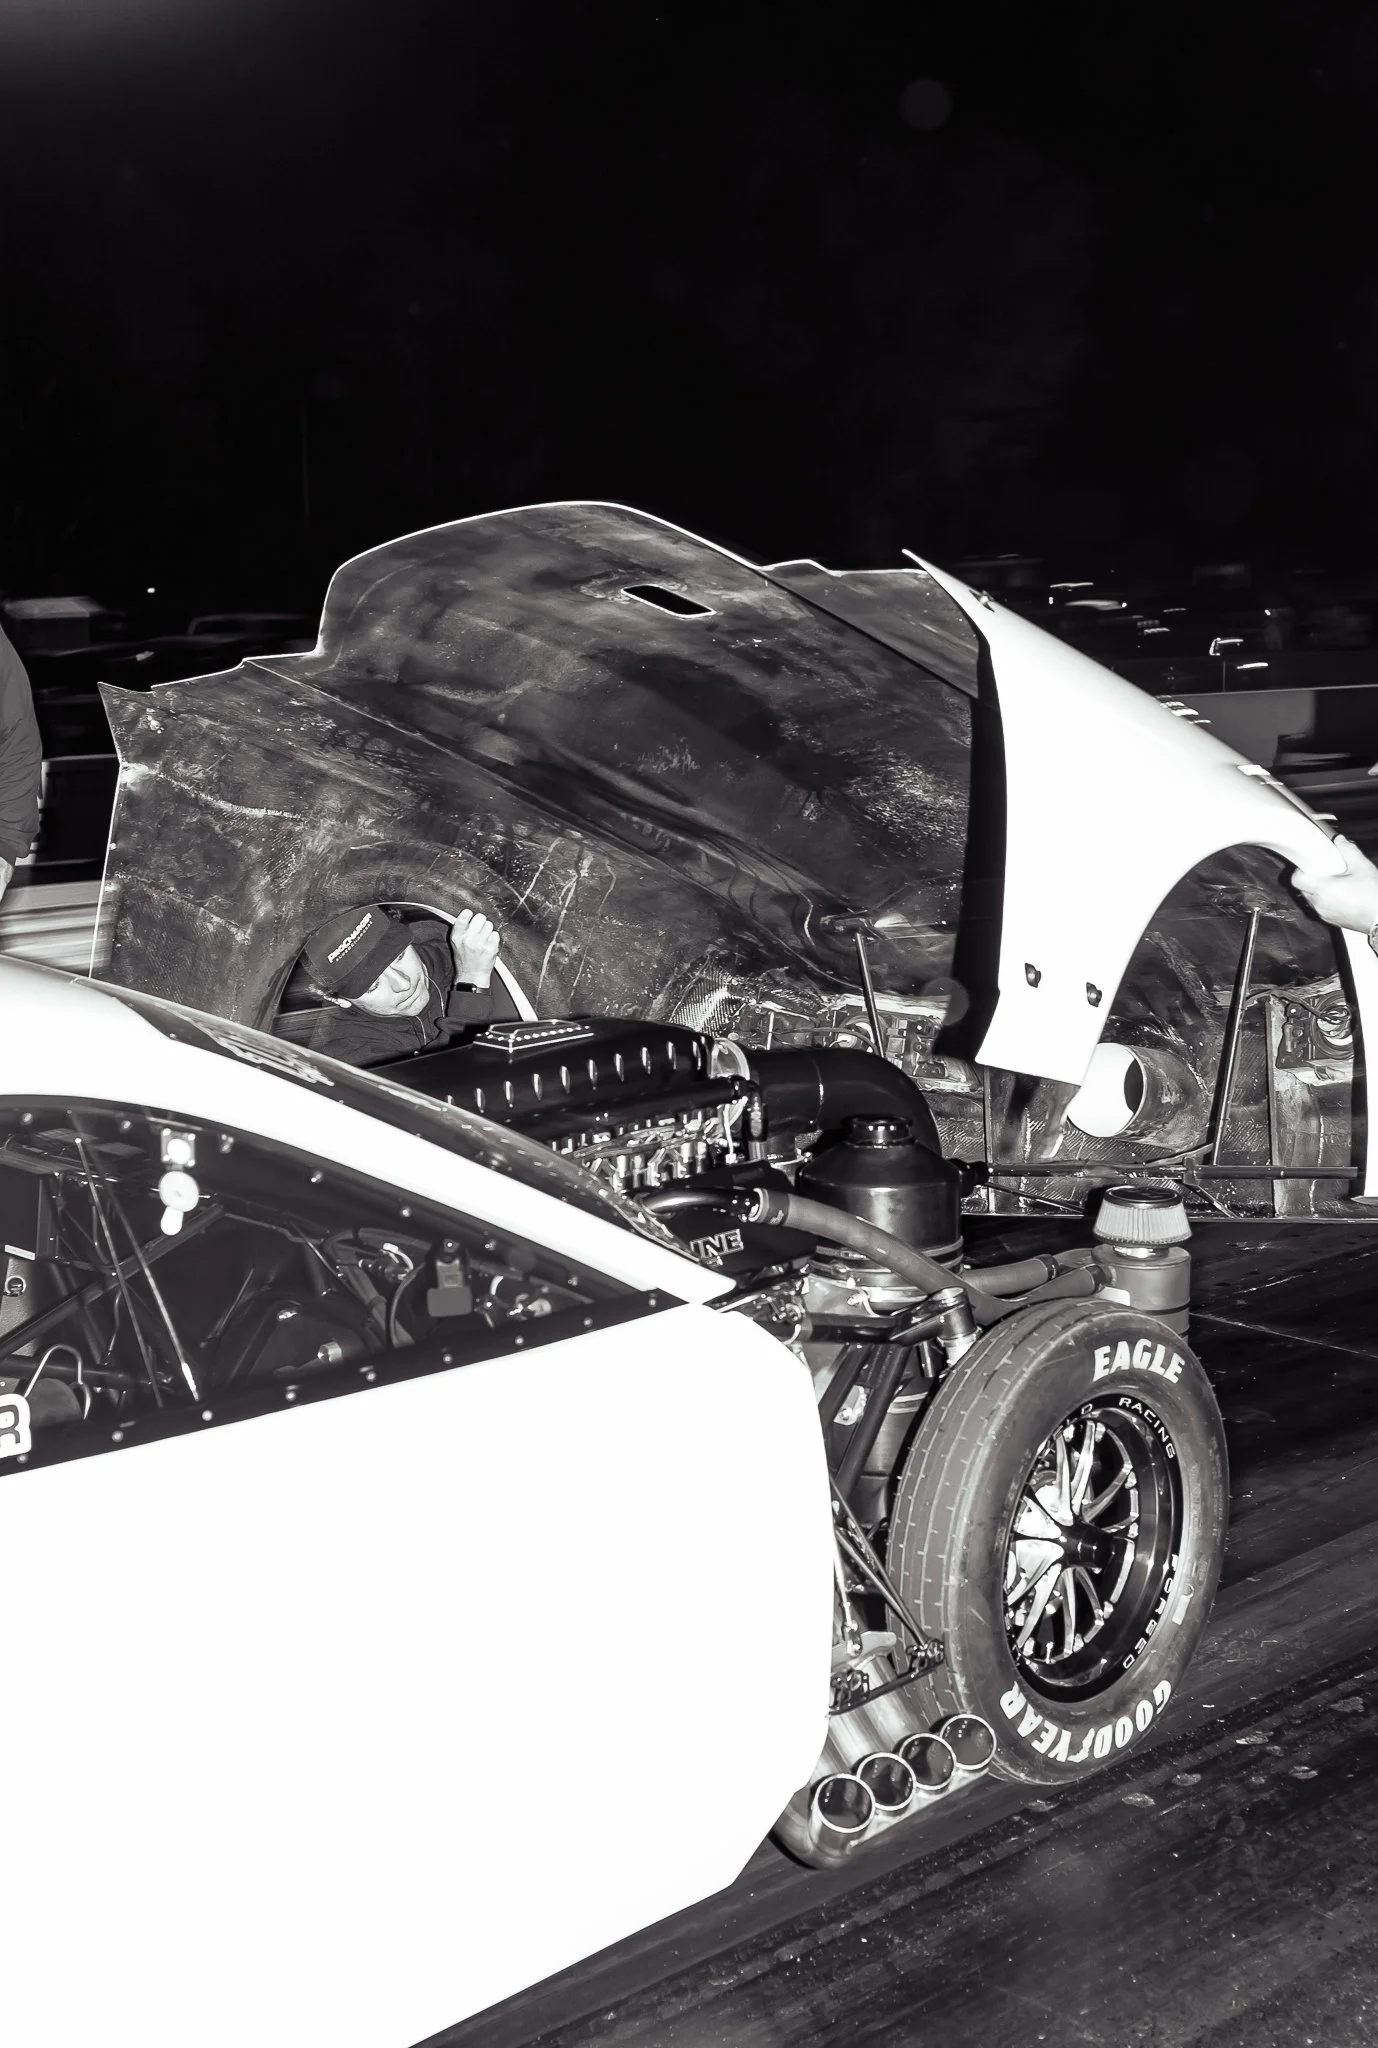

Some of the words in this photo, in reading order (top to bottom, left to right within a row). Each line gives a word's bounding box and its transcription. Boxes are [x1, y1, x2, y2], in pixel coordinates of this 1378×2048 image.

[1092, 1338, 1186, 1384] EAGLE
[1118, 1397, 1176, 1459] RACING
[1122, 1553, 1179, 1669] FORGED
[999, 1680, 1172, 1763] GOODYEAR
